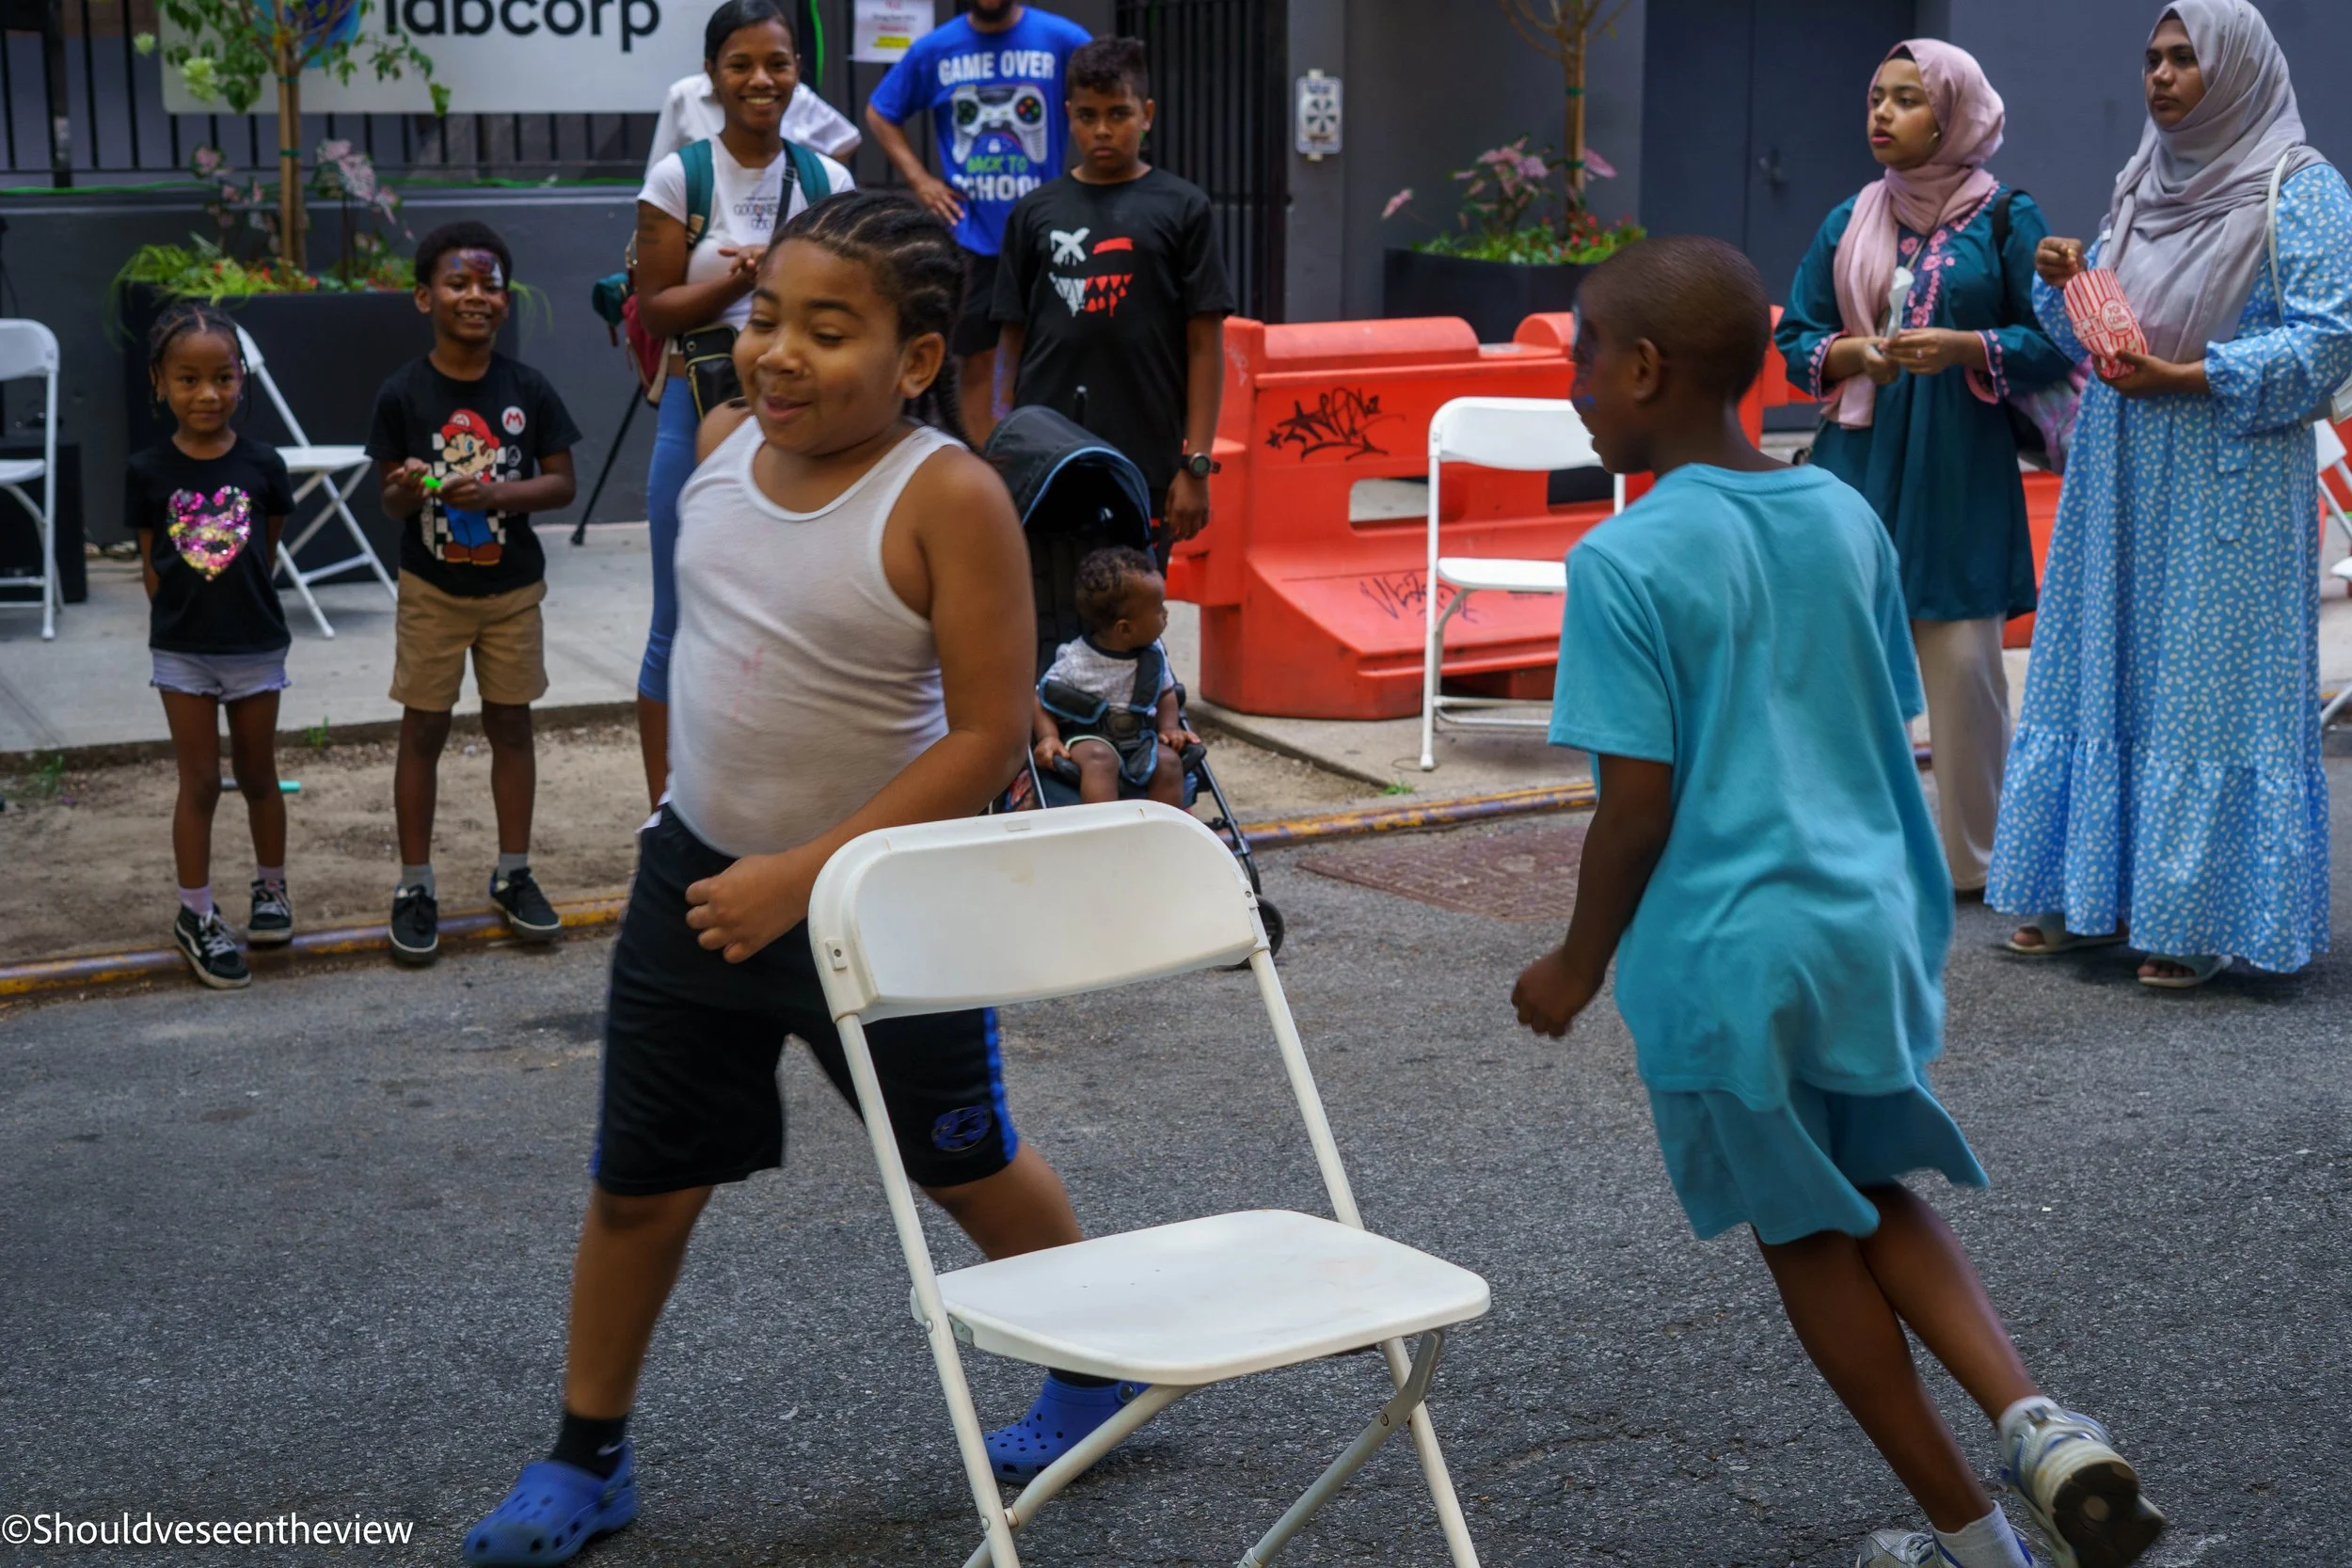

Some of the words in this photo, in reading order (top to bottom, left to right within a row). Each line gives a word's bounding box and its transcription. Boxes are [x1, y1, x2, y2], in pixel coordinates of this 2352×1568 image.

[385, 0, 661, 53] labcorp
[938, 52, 995, 87] GAME
[1000, 50, 1056, 80] OVER
[966, 154, 1003, 173] BACK
[1008, 154, 1028, 172] TO
[505, 412, 523, 427] M
